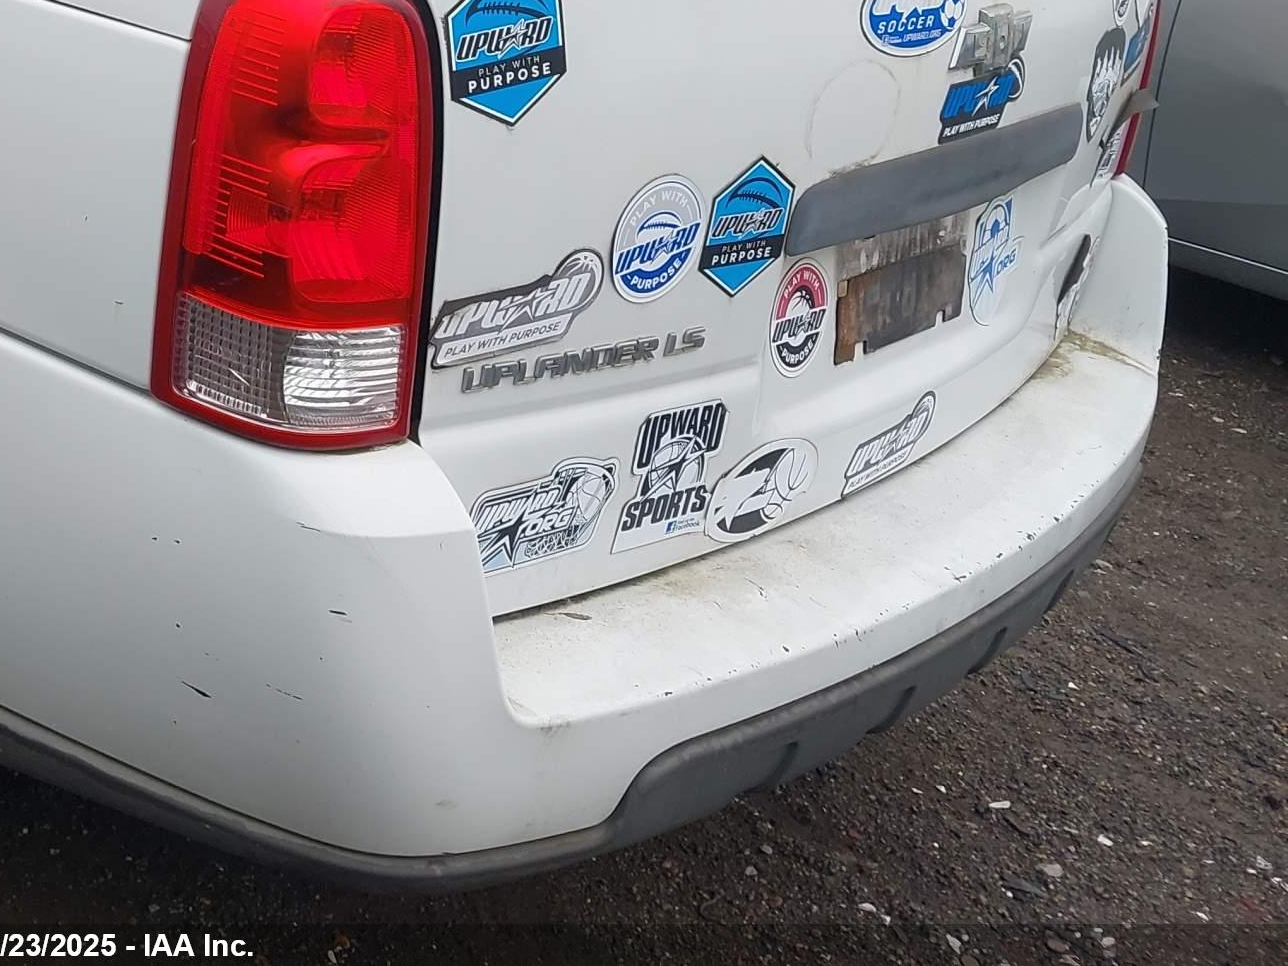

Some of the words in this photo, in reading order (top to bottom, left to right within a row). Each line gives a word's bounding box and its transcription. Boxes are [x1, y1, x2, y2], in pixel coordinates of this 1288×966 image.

[877, 15, 935, 34] SOCCER
[468, 62, 552, 94] PURPOSE
[478, 63, 507, 77] PLAY
[512, 55, 541, 69] WITH
[942, 125, 961, 138] PLAY
[959, 121, 975, 133] WITH
[629, 195, 657, 226] PLAY
[661, 190, 689, 207] WITH
[711, 246, 772, 266] PURPOSE
[721, 242, 743, 253] PLAY
[745, 240, 767, 249] WITH
[630, 258, 683, 290] PURPOSE
[783, 271, 803, 299] PLAY
[803, 269, 821, 290] WITH
[443, 341, 476, 359] PLAY
[476, 334, 508, 350] WITH
[509, 320, 562, 343] PURPOSE
[781, 340, 815, 364] PURPOSE
[461, 335, 660, 394] UPLANDER
[663, 325, 706, 357] LS
[636, 402, 728, 470] UPWARD
[620, 485, 709, 532] SPORTS
